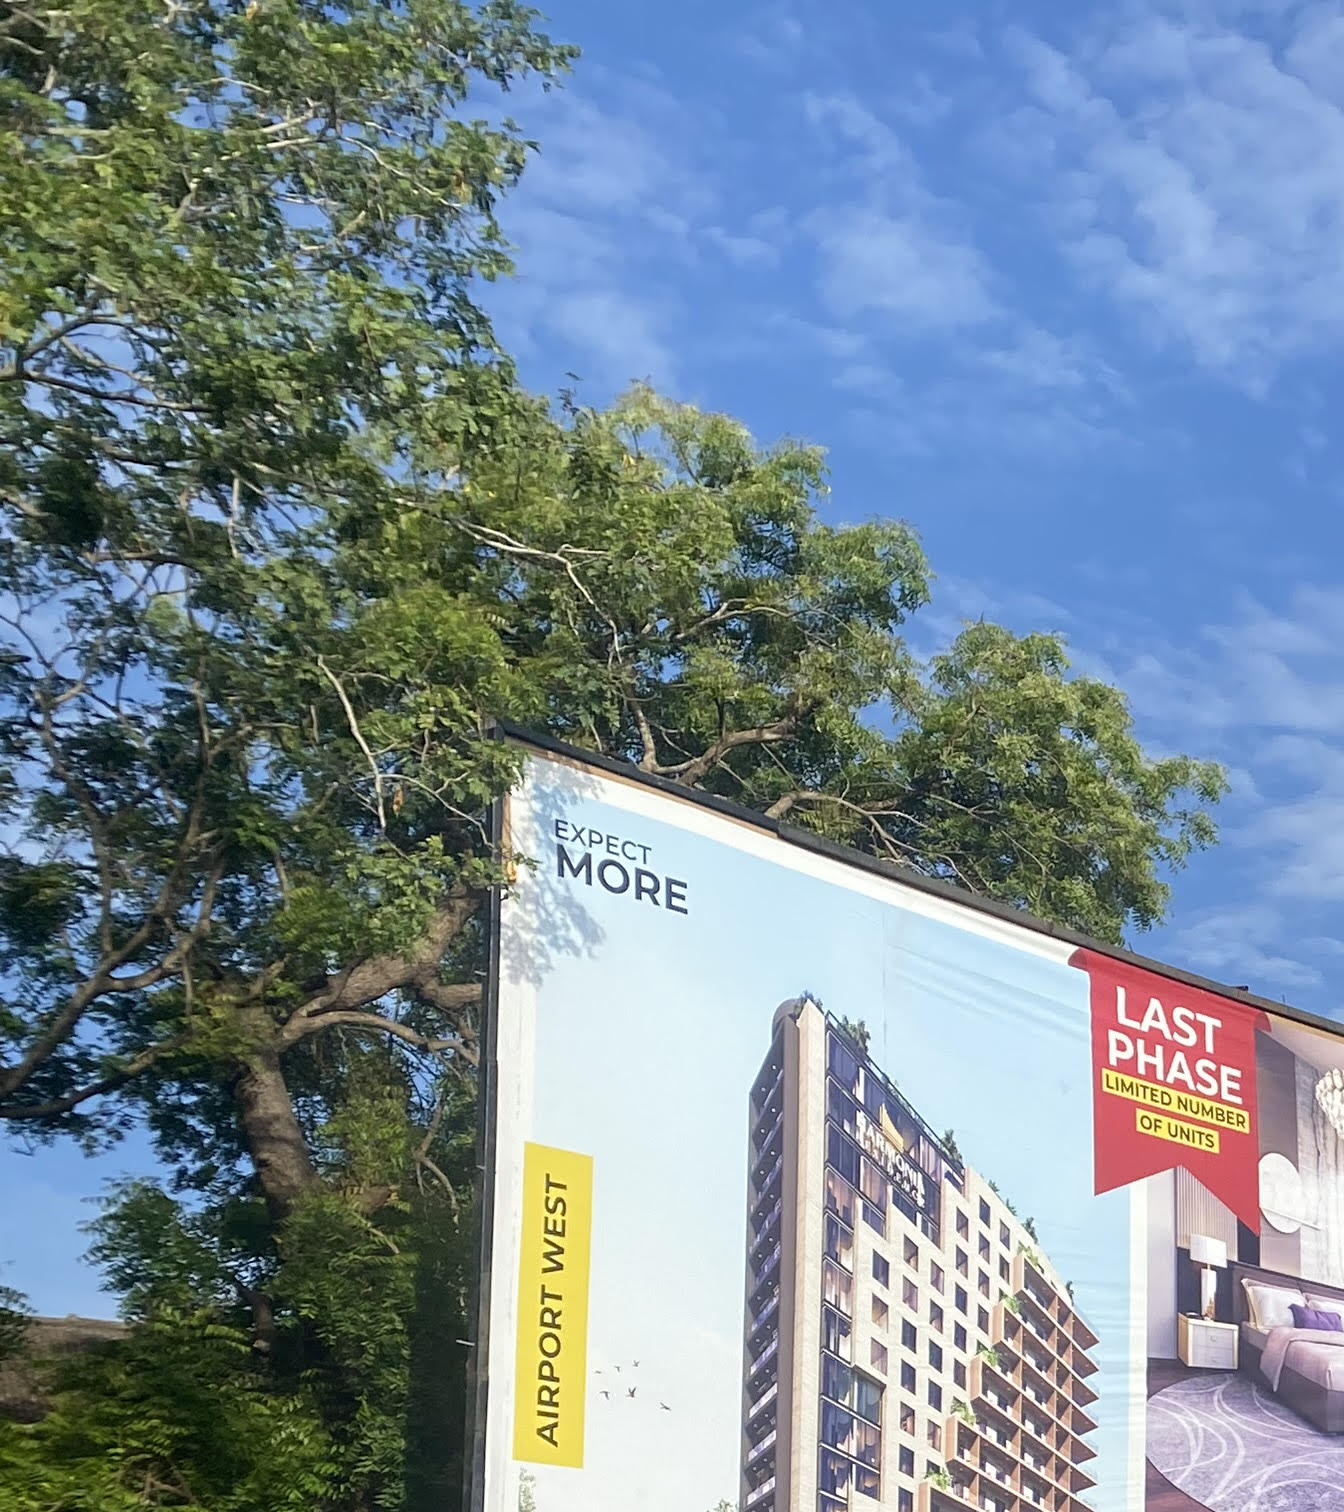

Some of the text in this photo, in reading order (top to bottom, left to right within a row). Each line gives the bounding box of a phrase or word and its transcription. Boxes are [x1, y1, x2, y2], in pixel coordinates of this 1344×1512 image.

[555, 818, 652, 865] EXPECT
[556, 843, 689, 915] MORE
[1115, 985, 1222, 1055] LAST
[1104, 1073, 1247, 1130] LIMITED NUMBER
[1107, 1028, 1243, 1105] PHASE
[1139, 1114, 1216, 1149] OF UNITS
[535, 1172, 568, 1448] AIRPORT WEST
